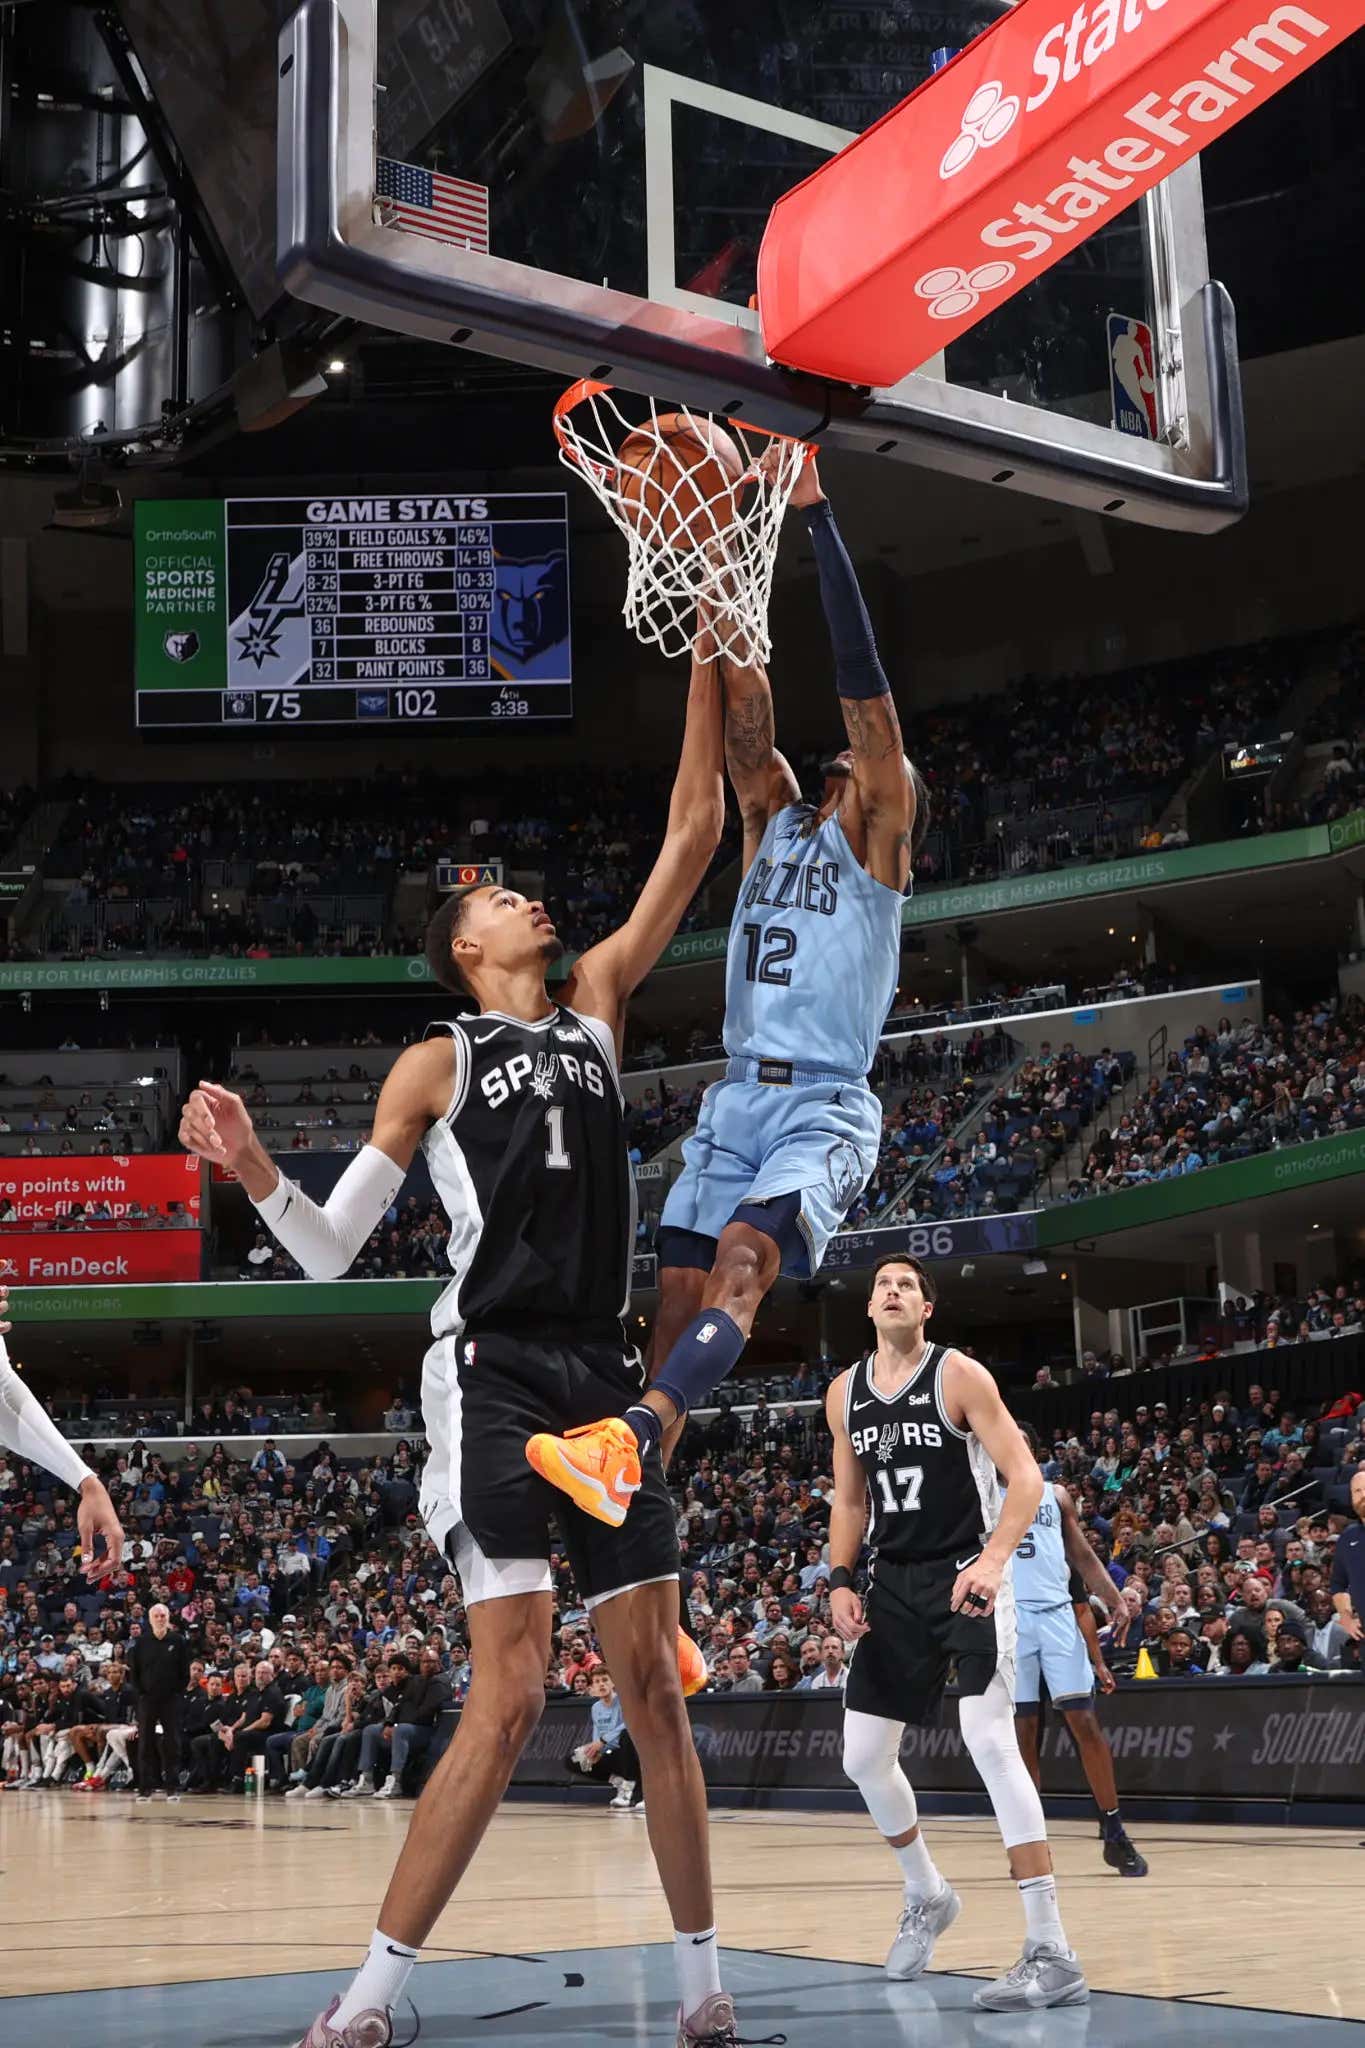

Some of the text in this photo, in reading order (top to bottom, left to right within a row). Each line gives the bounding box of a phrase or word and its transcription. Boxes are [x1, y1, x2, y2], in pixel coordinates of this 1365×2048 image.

[1120, 409, 1143, 433] NBA
[306, 499, 488, 522] GAME STATS
[145, 530, 217, 541] OrthoSouth
[306, 531, 336, 547] 39%
[349, 529, 446, 546] FIELD GOALS %
[460, 528, 489, 544] 46%
[145, 556, 216, 569] OFFICIAL
[307, 553, 335, 568] 8-14
[353, 551, 444, 568] FREE THROWS
[458, 550, 491, 565] 14-19
[145, 570, 216, 585] SPORTS
[307, 575, 337, 591] 8-25
[373, 573, 424, 589] 3-PT FG
[457, 572, 493, 587] 10-33
[146, 587, 216, 599] MEDICINE
[146, 601, 216, 613] PARTNER
[308, 596, 337, 612] 32%
[365, 594, 433, 611] 3-PT FG %
[460, 594, 490, 609] 30%
[315, 618, 331, 634] 36
[365, 617, 435, 633] REBOUNDS
[469, 616, 483, 631] 37
[319, 641, 326, 656] 7
[375, 638, 426, 655] BLOCKS
[472, 638, 481, 652] 8
[315, 663, 332, 678] 32
[356, 660, 445, 677] PAINT POINTS
[469, 659, 485, 674] 36
[261, 692, 301, 719] 75
[395, 688, 437, 716] 102
[491, 701, 528, 716] 3:38
[942, 895, 972, 911] FOR
[977, 888, 1006, 909] THE
[1010, 878, 1083, 901] MEMPHIS
[1087, 861, 1165, 887] GRIZZLIES
[743, 922, 797, 987] 12
[38, 969, 69, 983] FOR
[73, 969, 102, 982] THE
[106, 967, 179, 982] MEMPHIS
[182, 966, 257, 981] GRIZZLIES
[480, 1051, 605, 1110] SPURS
[545, 1105, 572, 1169] 1
[638, 1165, 660, 1177] 107A
[22, 1177, 80, 1197] points
[85, 1175, 126, 1192] with
[865, 1235, 874, 1247] 4
[908, 1227, 954, 1257] 86
[642, 1260, 651, 1272] 3
[842, 1252, 852, 1264] 2
[29, 1256, 129, 1277] FanDeck
[908, 1392, 931, 1406] Self.
[851, 1422, 943, 1464] SPURS
[876, 1465, 924, 1514] 17
[706, 1730, 802, 1757] MINUTES
[1055, 1726, 1194, 1759] MMPHIS
